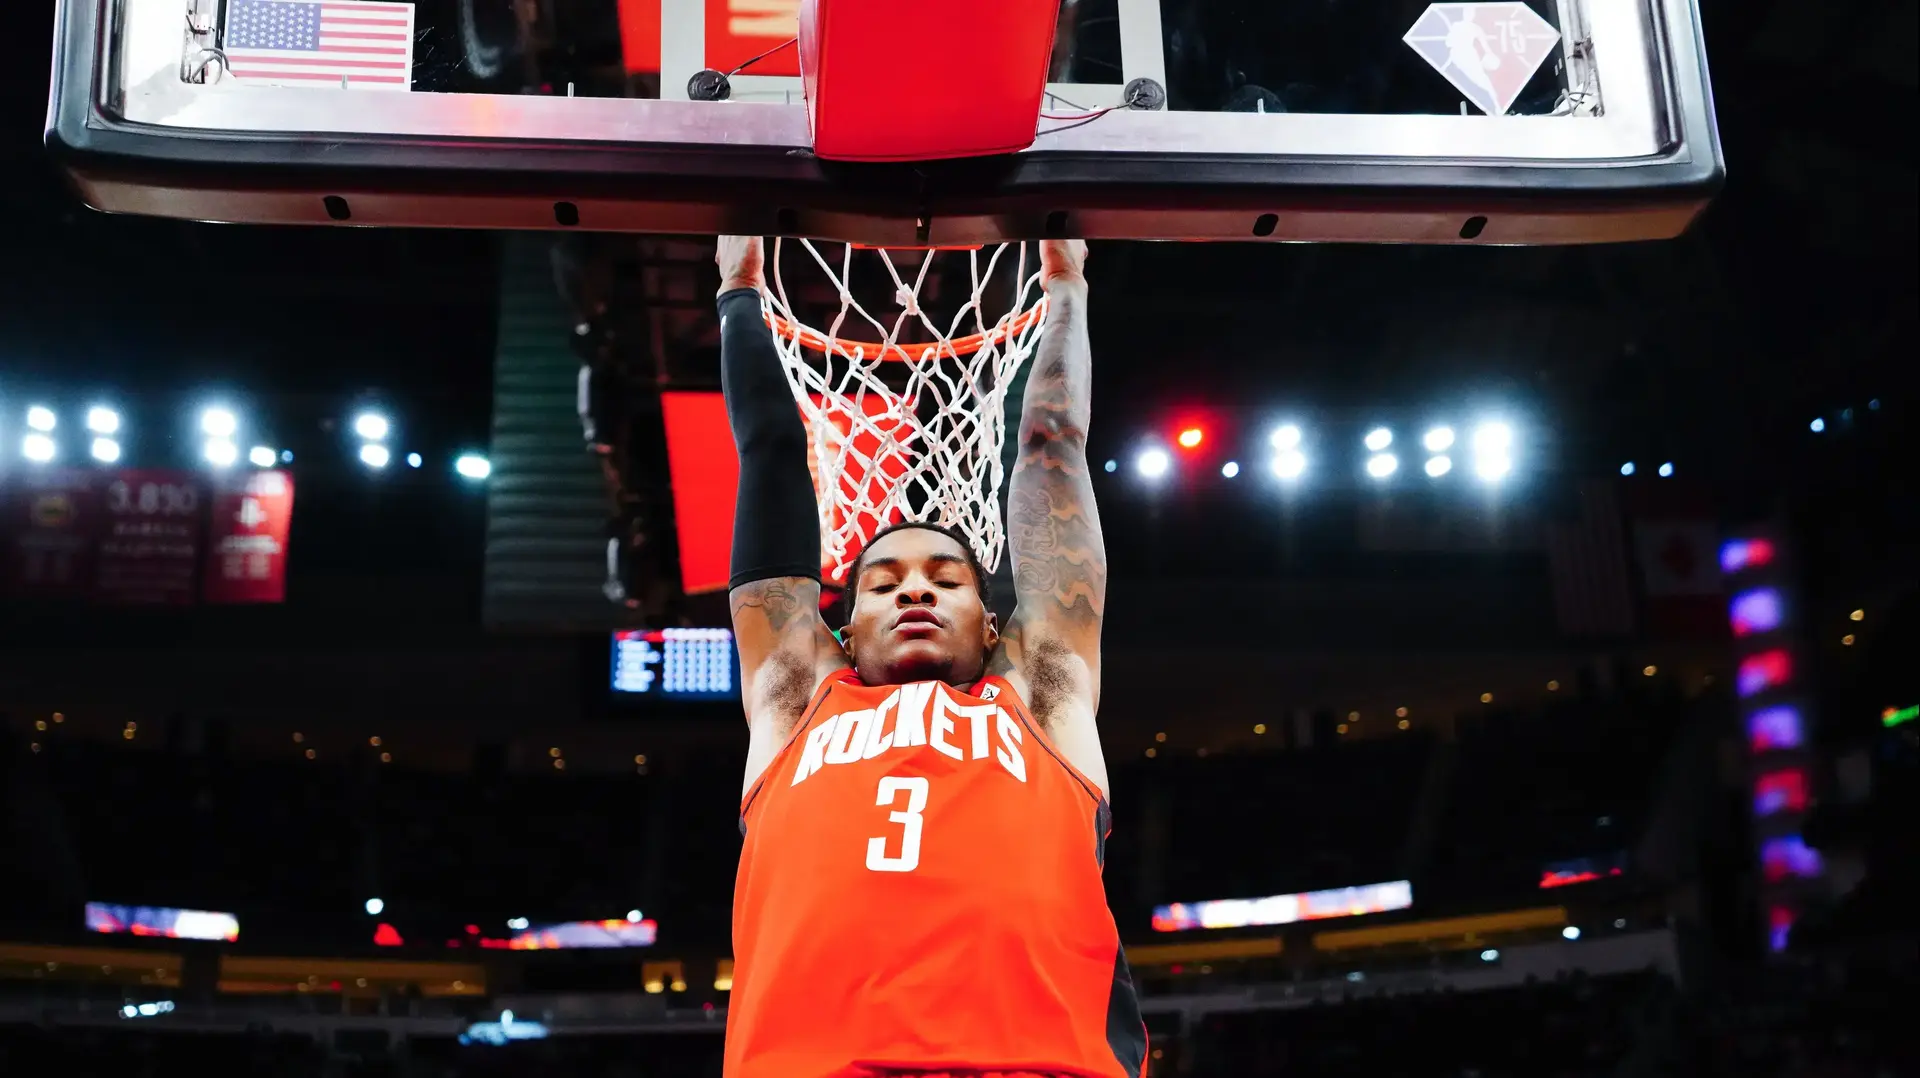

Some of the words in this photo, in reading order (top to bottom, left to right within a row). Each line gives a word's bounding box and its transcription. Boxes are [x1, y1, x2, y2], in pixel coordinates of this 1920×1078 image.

[1494, 20, 1527, 54] 75
[790, 680, 1027, 788] ROCKETS
[865, 776, 929, 872] 3
